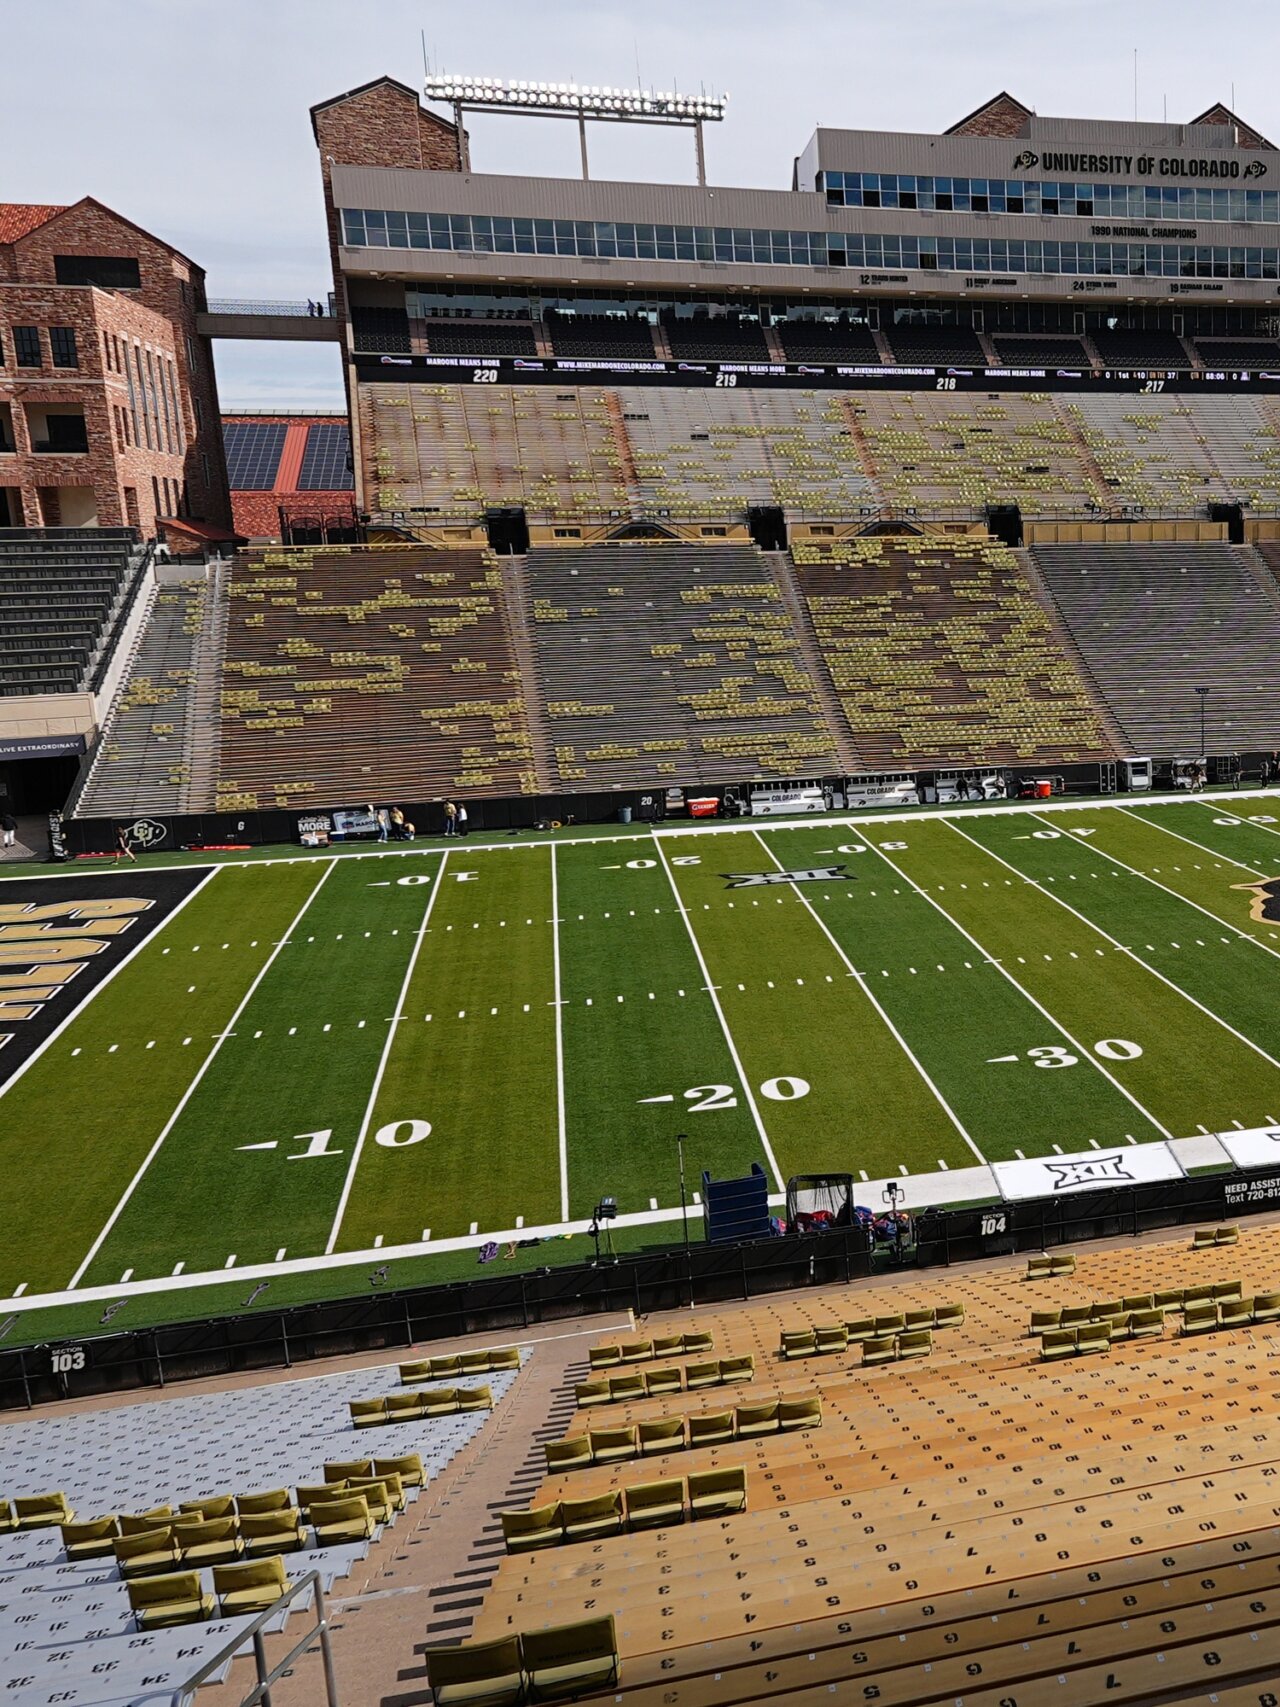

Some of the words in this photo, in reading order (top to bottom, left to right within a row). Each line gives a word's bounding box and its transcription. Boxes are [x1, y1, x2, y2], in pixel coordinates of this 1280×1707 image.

[1042, 152, 1133, 175] UNIVERSITY
[1138, 156, 1155, 175] OF
[1159, 158, 1239, 178] COLORADO
[1091, 226, 1111, 236] 1990
[1113, 227, 1150, 237] NATIONAL
[1152, 228, 1197, 239] CHAMPIONS
[860, 274, 870, 285] 12
[965, 278, 973, 288] 11
[1073, 281, 1084, 291] 24
[1170, 283, 1179, 293] 19
[426, 358, 458, 366] MAROONE
[482, 359, 500, 367] MORE
[473, 369, 498, 382] 220
[715, 374, 737, 387] 219
[936, 377, 956, 390] 218
[1146, 381, 1164, 392] 217
[866, 787, 896, 795] COLORADO
[642, 796, 653, 805] 20
[771, 793, 802, 802] COLORADO
[298, 821, 331, 832] MORE
[1026, 1038, 1144, 1069] 30
[683, 1076, 811, 1112] 20
[286, 1119, 433, 1160] 10
[1224, 1183, 1248, 1194] NEED
[1225, 1193, 1244, 1204] Text
[981, 1217, 1006, 1236] 104
[51, 1346, 83, 1355] SECTION
[51, 1352, 85, 1373] 103
